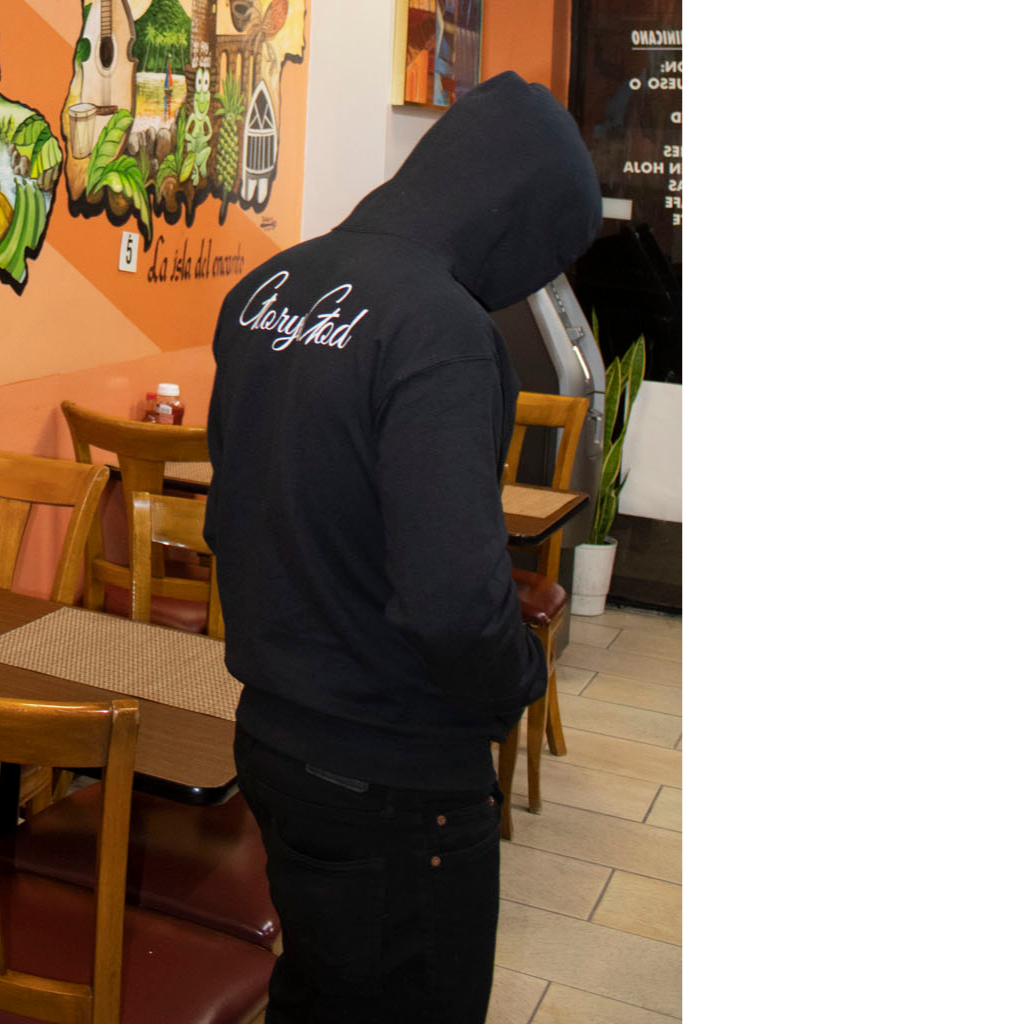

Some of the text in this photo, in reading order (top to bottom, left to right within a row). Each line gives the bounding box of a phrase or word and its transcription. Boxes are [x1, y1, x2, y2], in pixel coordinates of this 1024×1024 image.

[126, 238, 133, 265] 5
[148, 234, 168, 283] La
[170, 237, 192, 281] isla
[194, 237, 212, 279] del
